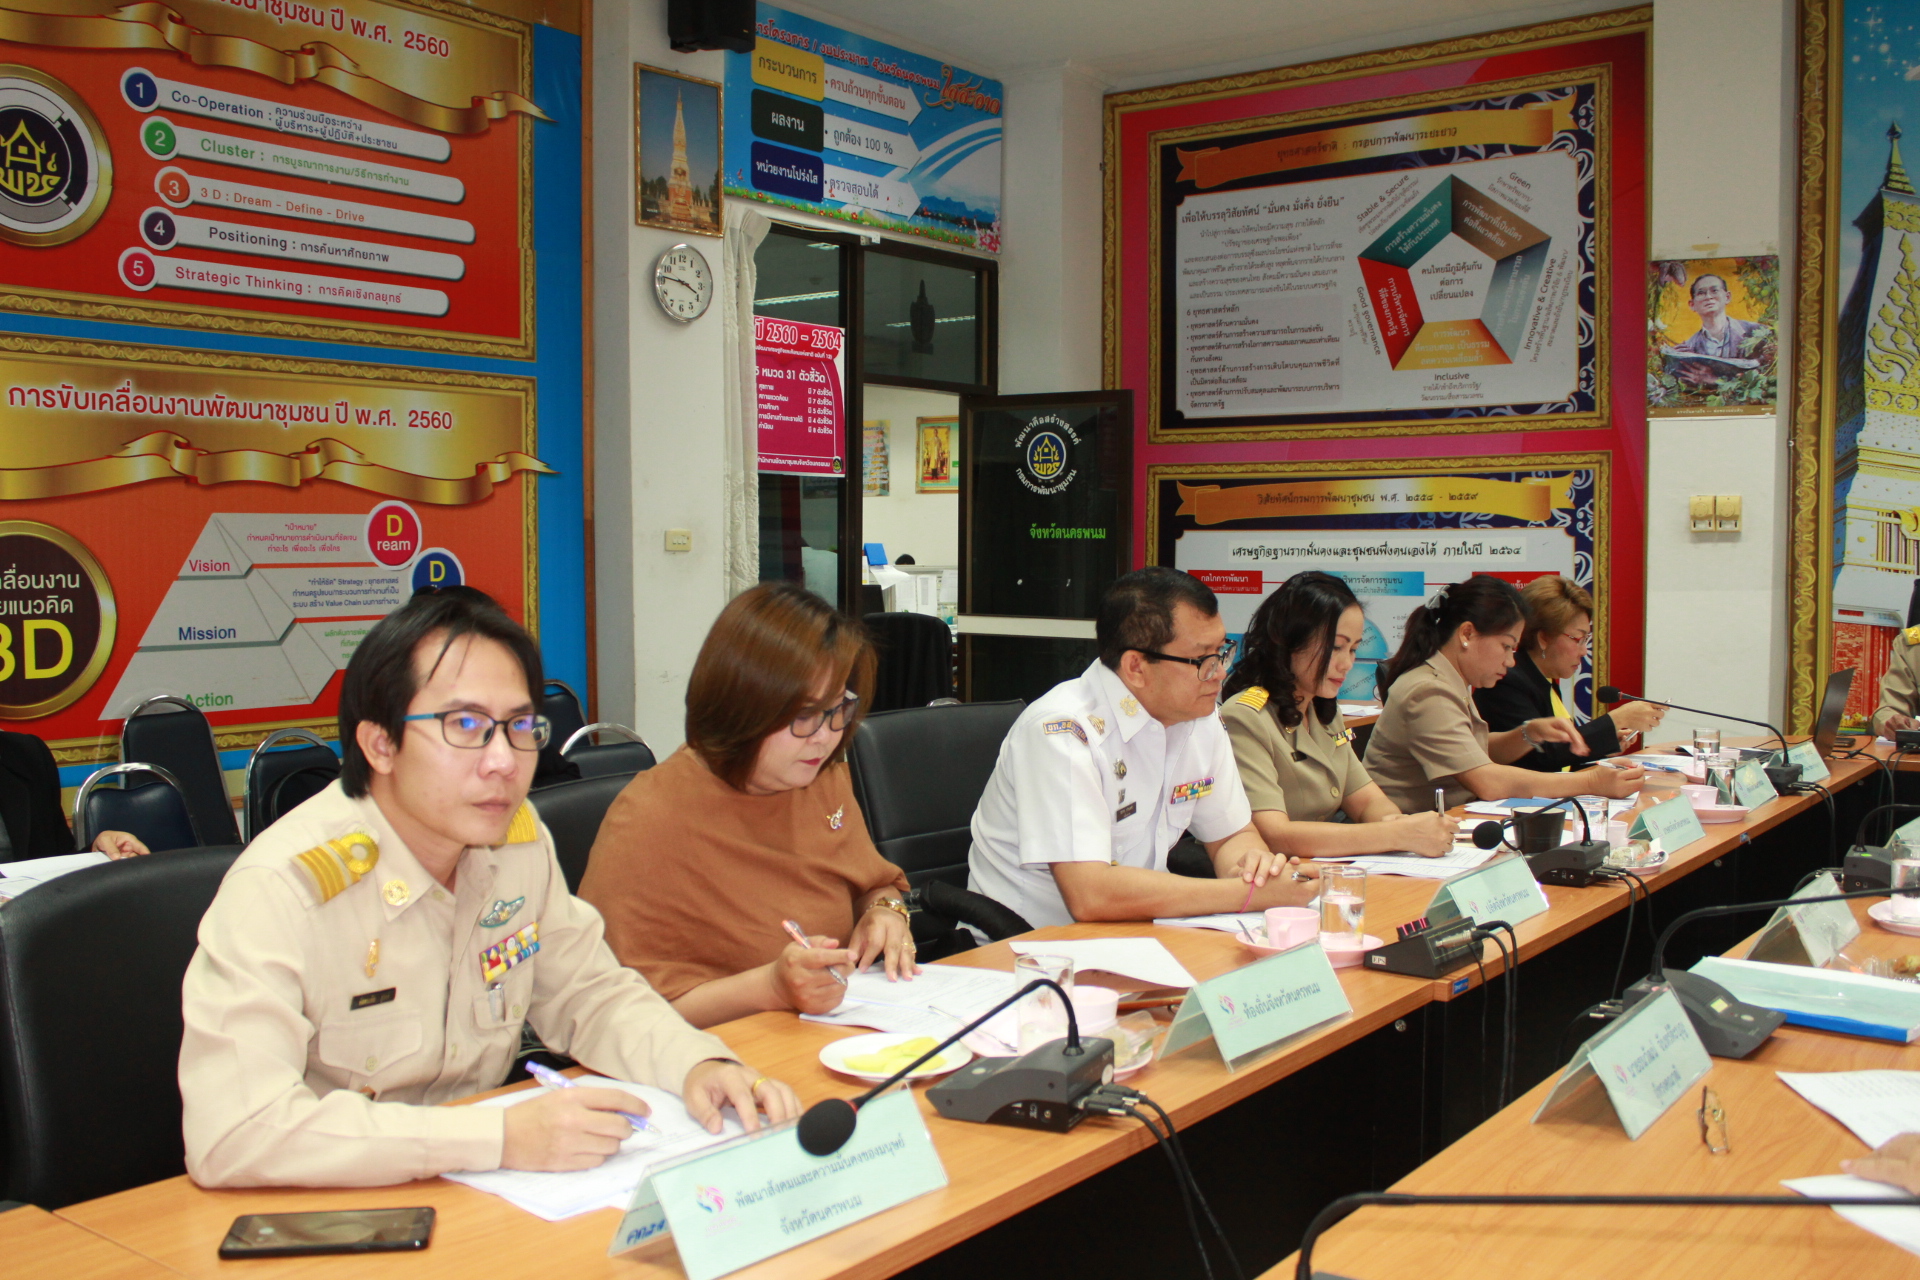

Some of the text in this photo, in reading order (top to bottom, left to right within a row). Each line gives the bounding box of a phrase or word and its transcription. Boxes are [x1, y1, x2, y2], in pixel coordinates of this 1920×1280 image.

[330, 8, 450, 58] ปี พ.ศ. 2560
[755, 20, 809, 49] ารโครงการ
[758, 56, 906, 110] กระบวนการ ครบถ้วนทุกขั้นตอน
[135, 82, 264, 120] 1 Co-Operation
[275, 106, 363, 132] ความร่วมมือระหว่าง
[771, 111, 805, 132] ผลงาน
[833, 127, 861, 147] ถูกต้อง
[865, 137, 881, 152] 100
[154, 130, 166, 147] 2
[201, 138, 256, 160] Cluster
[756, 161, 879, 199] หน่วยงานโปร่งใส ตรวจสอบได้
[1509, 171, 1531, 190] Green
[168, 180, 365, 223] 3 3 D Dream Define Drive
[1356, 201, 1379, 222] Stable
[1385, 174, 1410, 197] Secure
[153, 219, 390, 263] 4 Positioning การค้นหาศักยภาพ
[132, 260, 402, 305] 5 Strategic Thinking การคิดเชิงกลยุทธ์
[1357, 286, 1369, 309] Good
[1524, 304, 1543, 350] Innovative
[1540, 258, 1557, 294] Creative
[766, 323, 798, 345] 2560
[811, 329, 842, 350] 2564
[1361, 309, 1381, 356] governance
[762, 368, 784, 379] หมวด
[786, 369, 796, 380] 31
[799, 366, 826, 383] ตัวชี้วัด
[1434, 372, 1470, 381] Inclusive
[9, 380, 453, 430] การขับเคลื่อนงานพัฒนาชุมชน ปี พ.ศ. 2560
[386, 514, 403, 537] D
[1029, 522, 1107, 539] จังหวัดนครพนม
[377, 540, 411, 551] ream
[0, 563, 80, 590] ลื่อนงาน
[189, 559, 230, 572] Vision
[429, 560, 446, 582] D
[344, 599, 362, 607] Chain
[178, 626, 236, 641] Mission
[185, 692, 234, 708] Action
[1243, 981, 1321, 1020] ท้องถิ่นจังหวัดนครพนม
[735, 1133, 905, 1208] พัฒนาสังคมและความมั่นคงของมนุษย์
[780, 1194, 863, 1236] จังหวัดนครพนม
